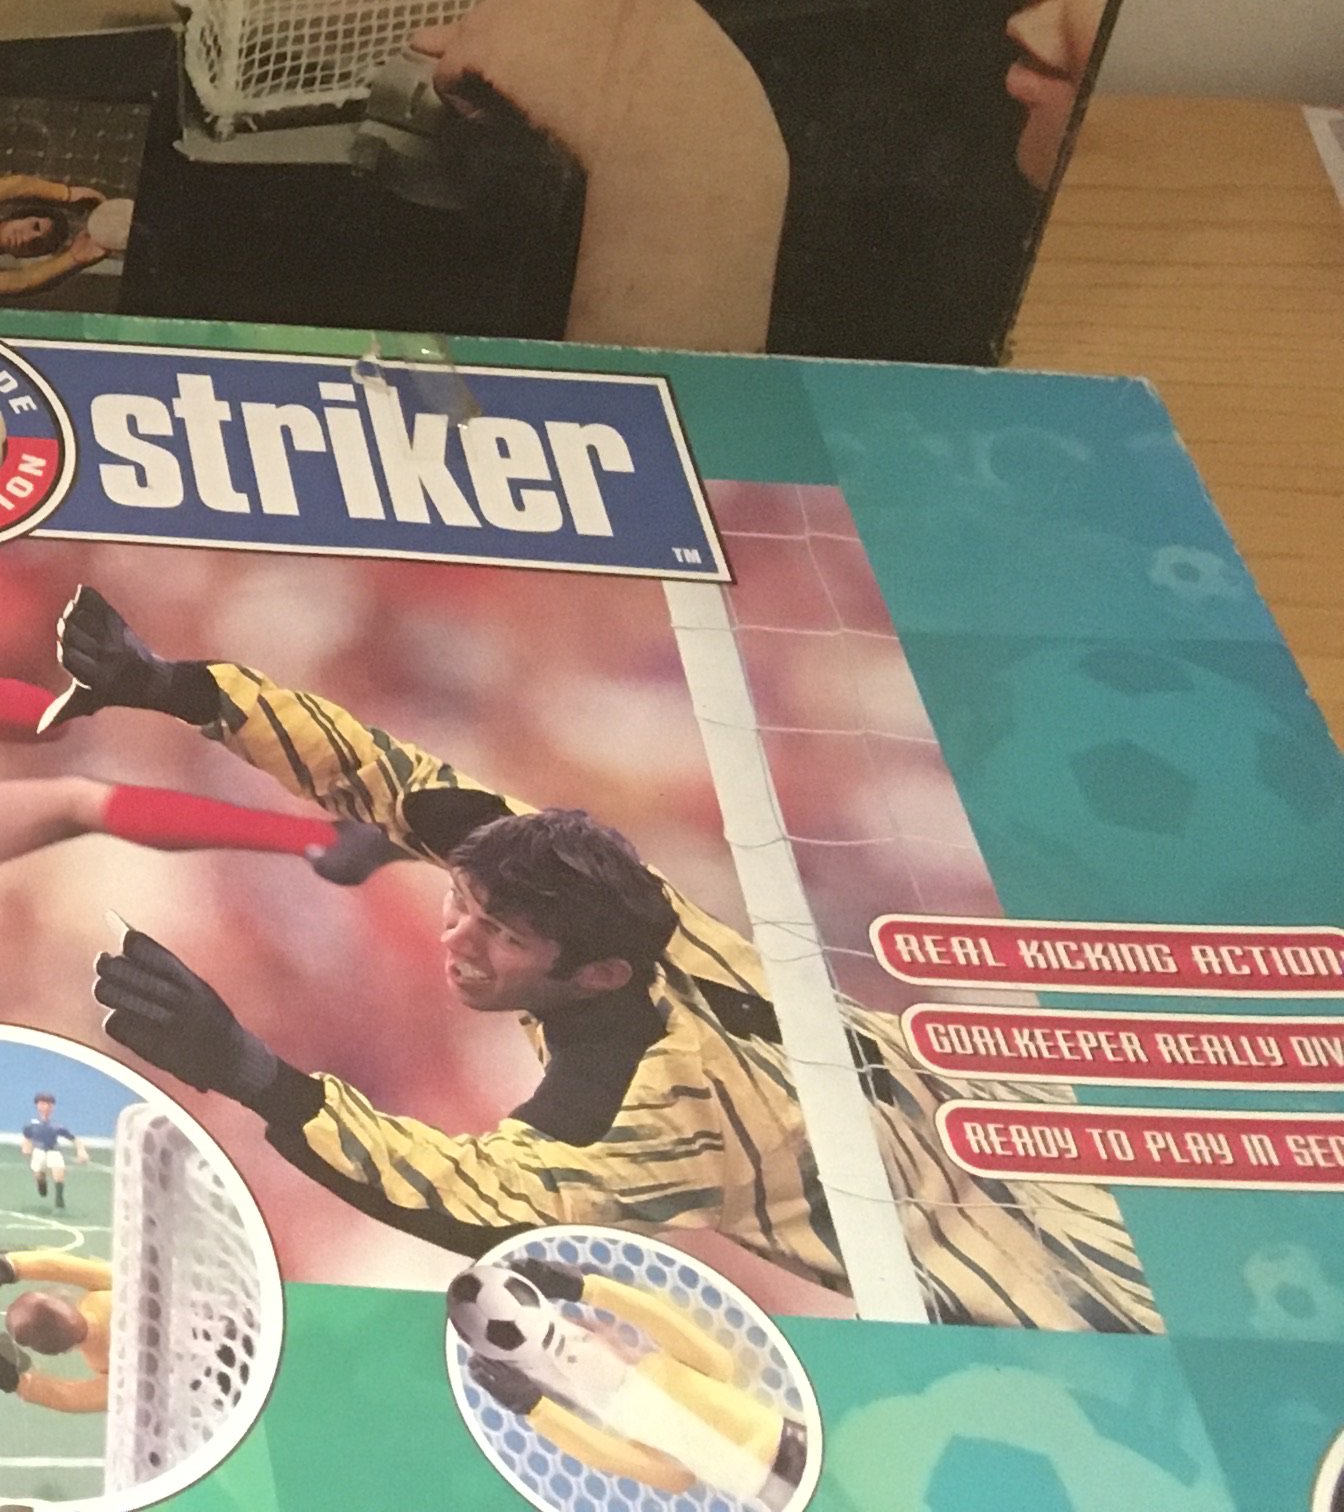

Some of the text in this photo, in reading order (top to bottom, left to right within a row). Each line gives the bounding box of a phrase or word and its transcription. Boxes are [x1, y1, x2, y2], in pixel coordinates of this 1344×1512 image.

[90, 366, 638, 543] striker
[671, 547, 702, 564] TM
[893, 933, 1344, 976] REAL KICKING ACTION
[924, 1022, 1150, 1064] GOALKEEPER
[1155, 1032, 1287, 1069] REALLY
[962, 1120, 1080, 1160] READY
[1085, 1127, 1136, 1162] TO
[1144, 1131, 1234, 1165] PLAY
[1240, 1134, 1281, 1167] IN
